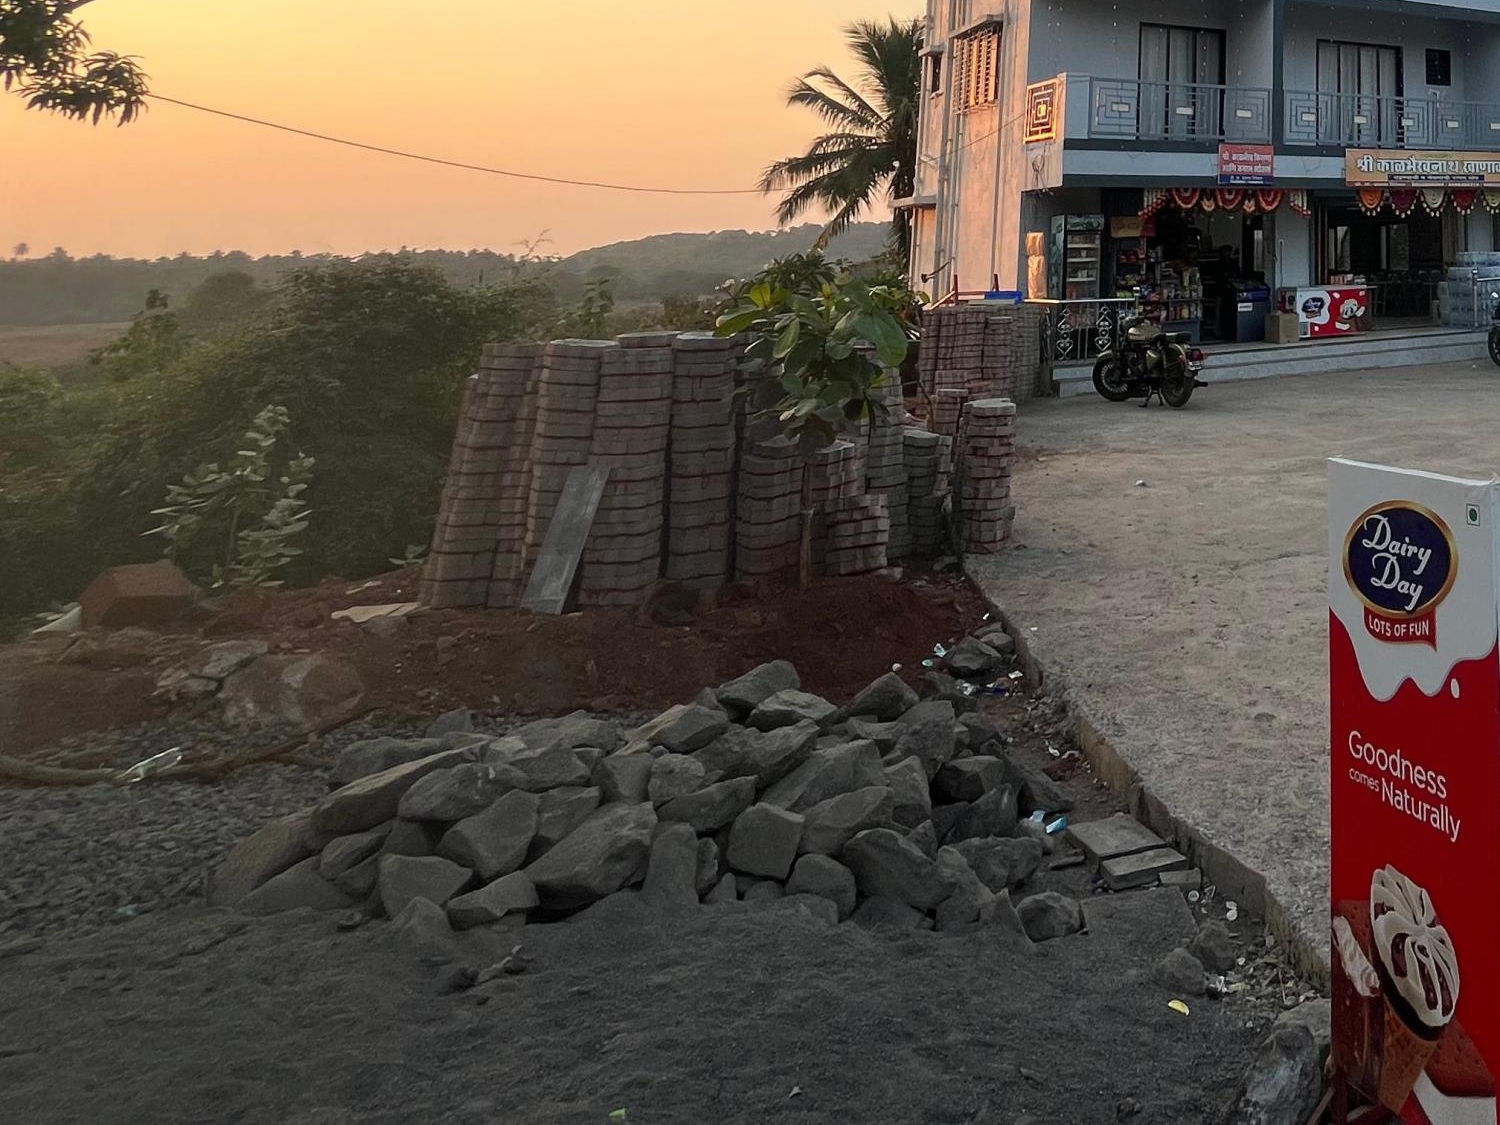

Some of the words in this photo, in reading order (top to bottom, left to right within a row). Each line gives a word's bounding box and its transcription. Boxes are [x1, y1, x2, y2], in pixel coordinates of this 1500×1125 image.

[1356, 154, 1374, 173] श्री
[1361, 513, 1433, 576] Dairy
[1369, 551, 1424, 612] Day
[1368, 613, 1392, 637] LOTS
[1393, 622, 1408, 638] OF
[1408, 618, 1430, 637] FUN
[1348, 729, 1448, 800] Goodness
[1348, 767, 1380, 793] comes
[1380, 776, 1461, 843] Naturally
